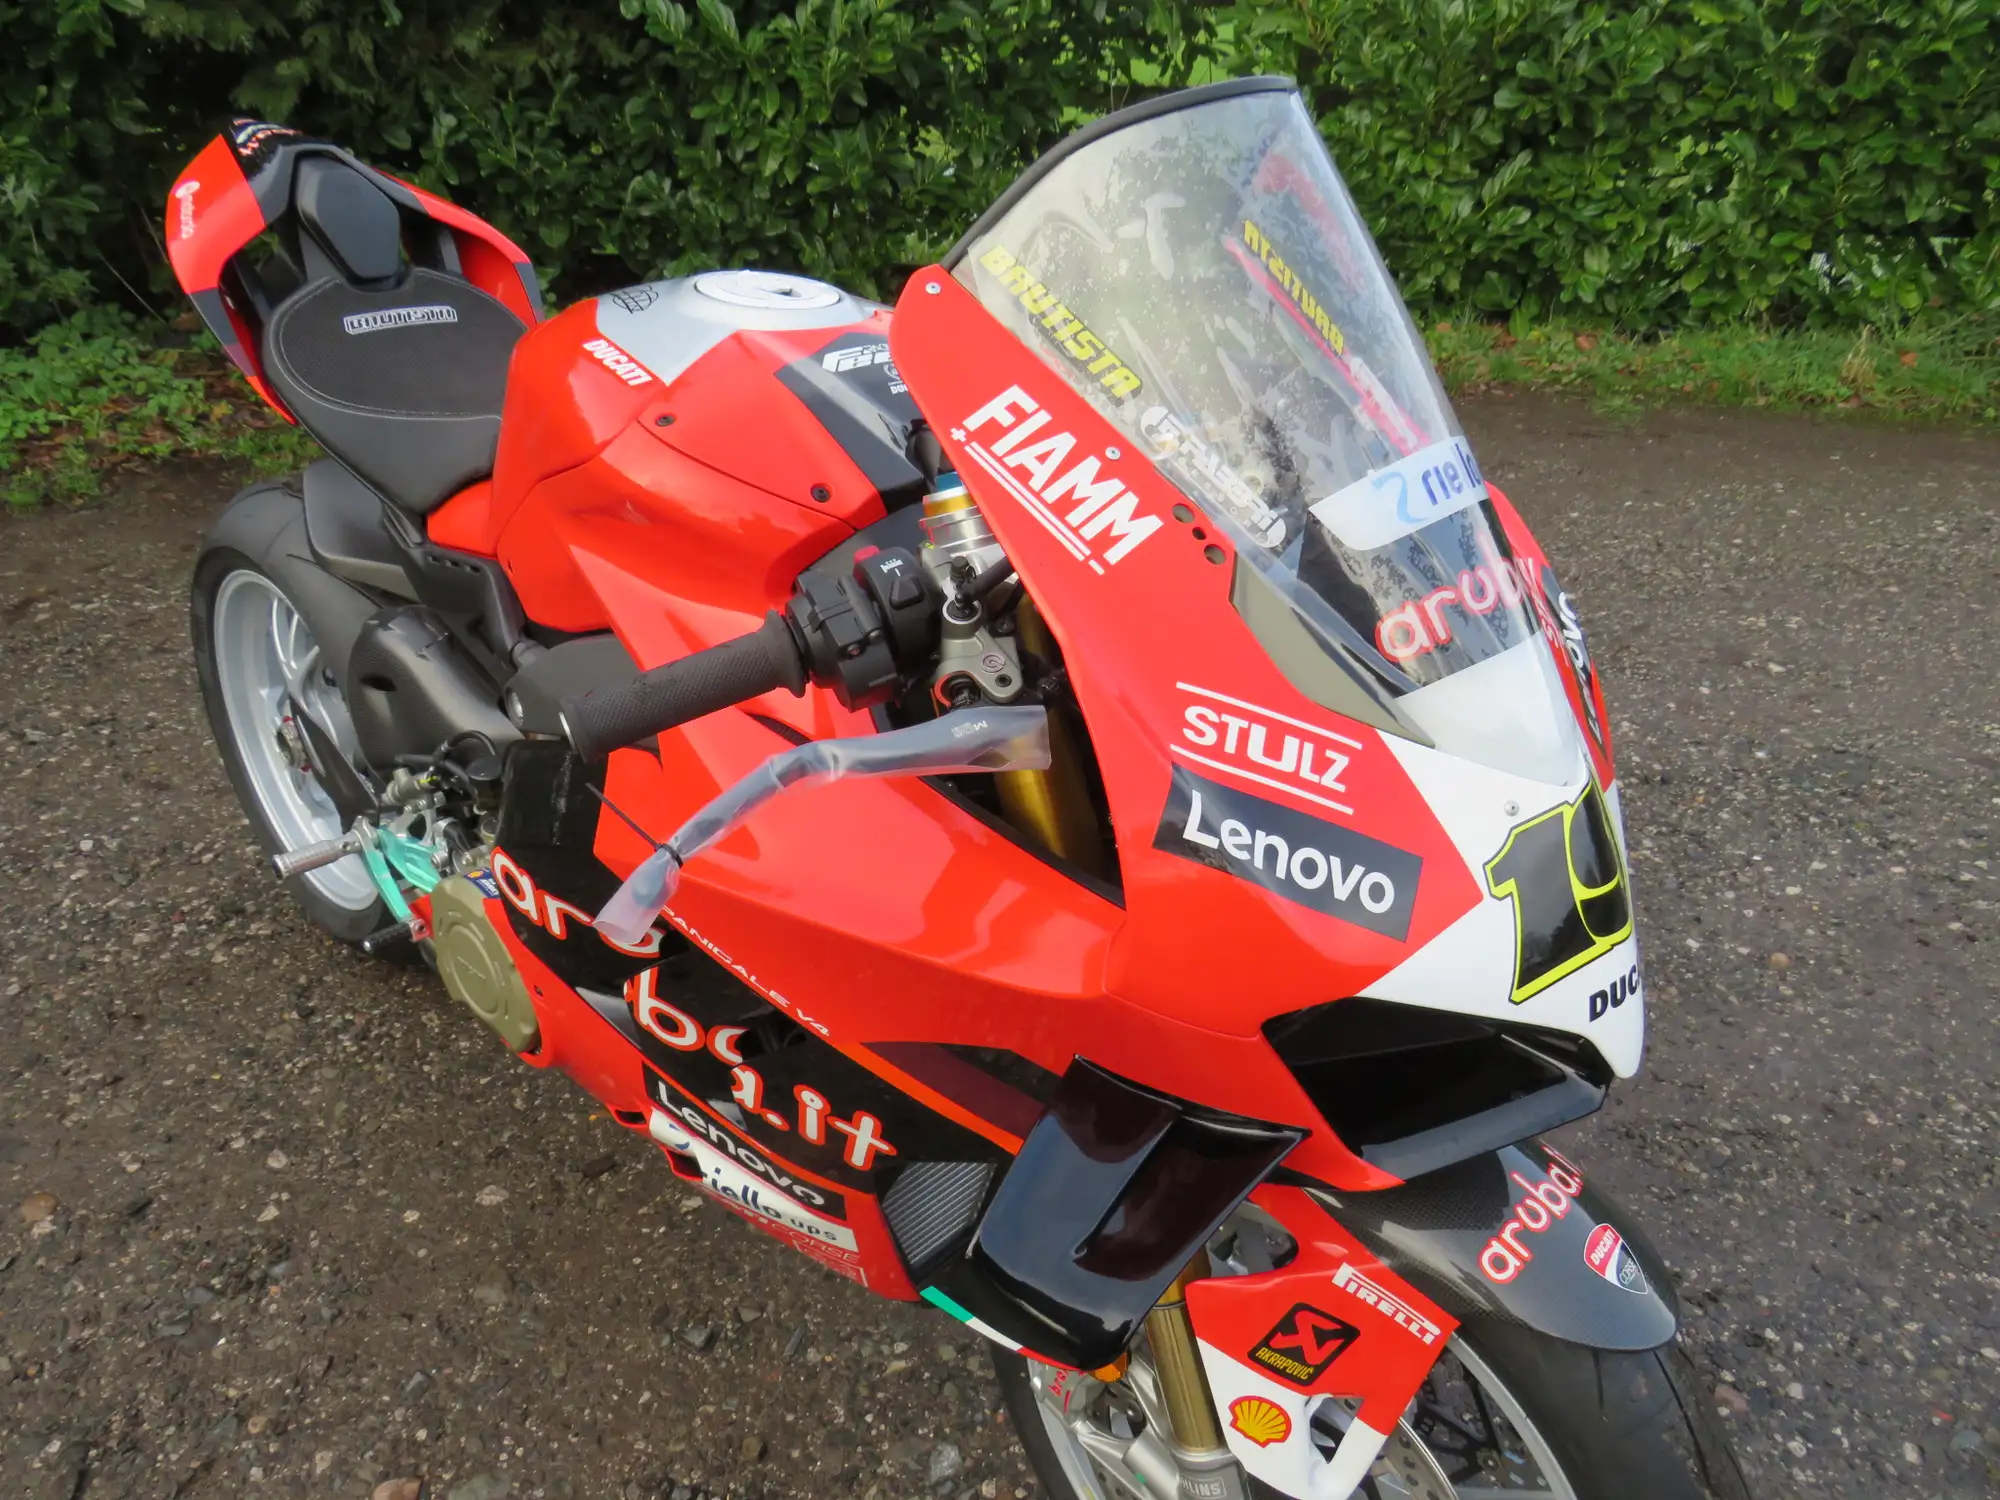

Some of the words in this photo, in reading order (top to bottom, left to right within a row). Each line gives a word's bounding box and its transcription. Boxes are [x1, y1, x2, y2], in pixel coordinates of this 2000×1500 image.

[582, 339, 653, 387] DUCATI
[979, 244, 1143, 400] BAUTISTA
[962, 384, 1164, 566] FIAMM
[1376, 530, 1527, 661] arub
[1182, 706, 1349, 793] STULZ
[1182, 790, 1395, 914] Lenovo
[796, 1007, 830, 1037] V4
[1589, 964, 1640, 1023] DUC
[658, 1081, 824, 1205] Lenovo
[790, 1218, 837, 1240] ups
[1590, 1228, 1616, 1266] DUCATI
[1331, 1262, 1441, 1345] PIRELLI
